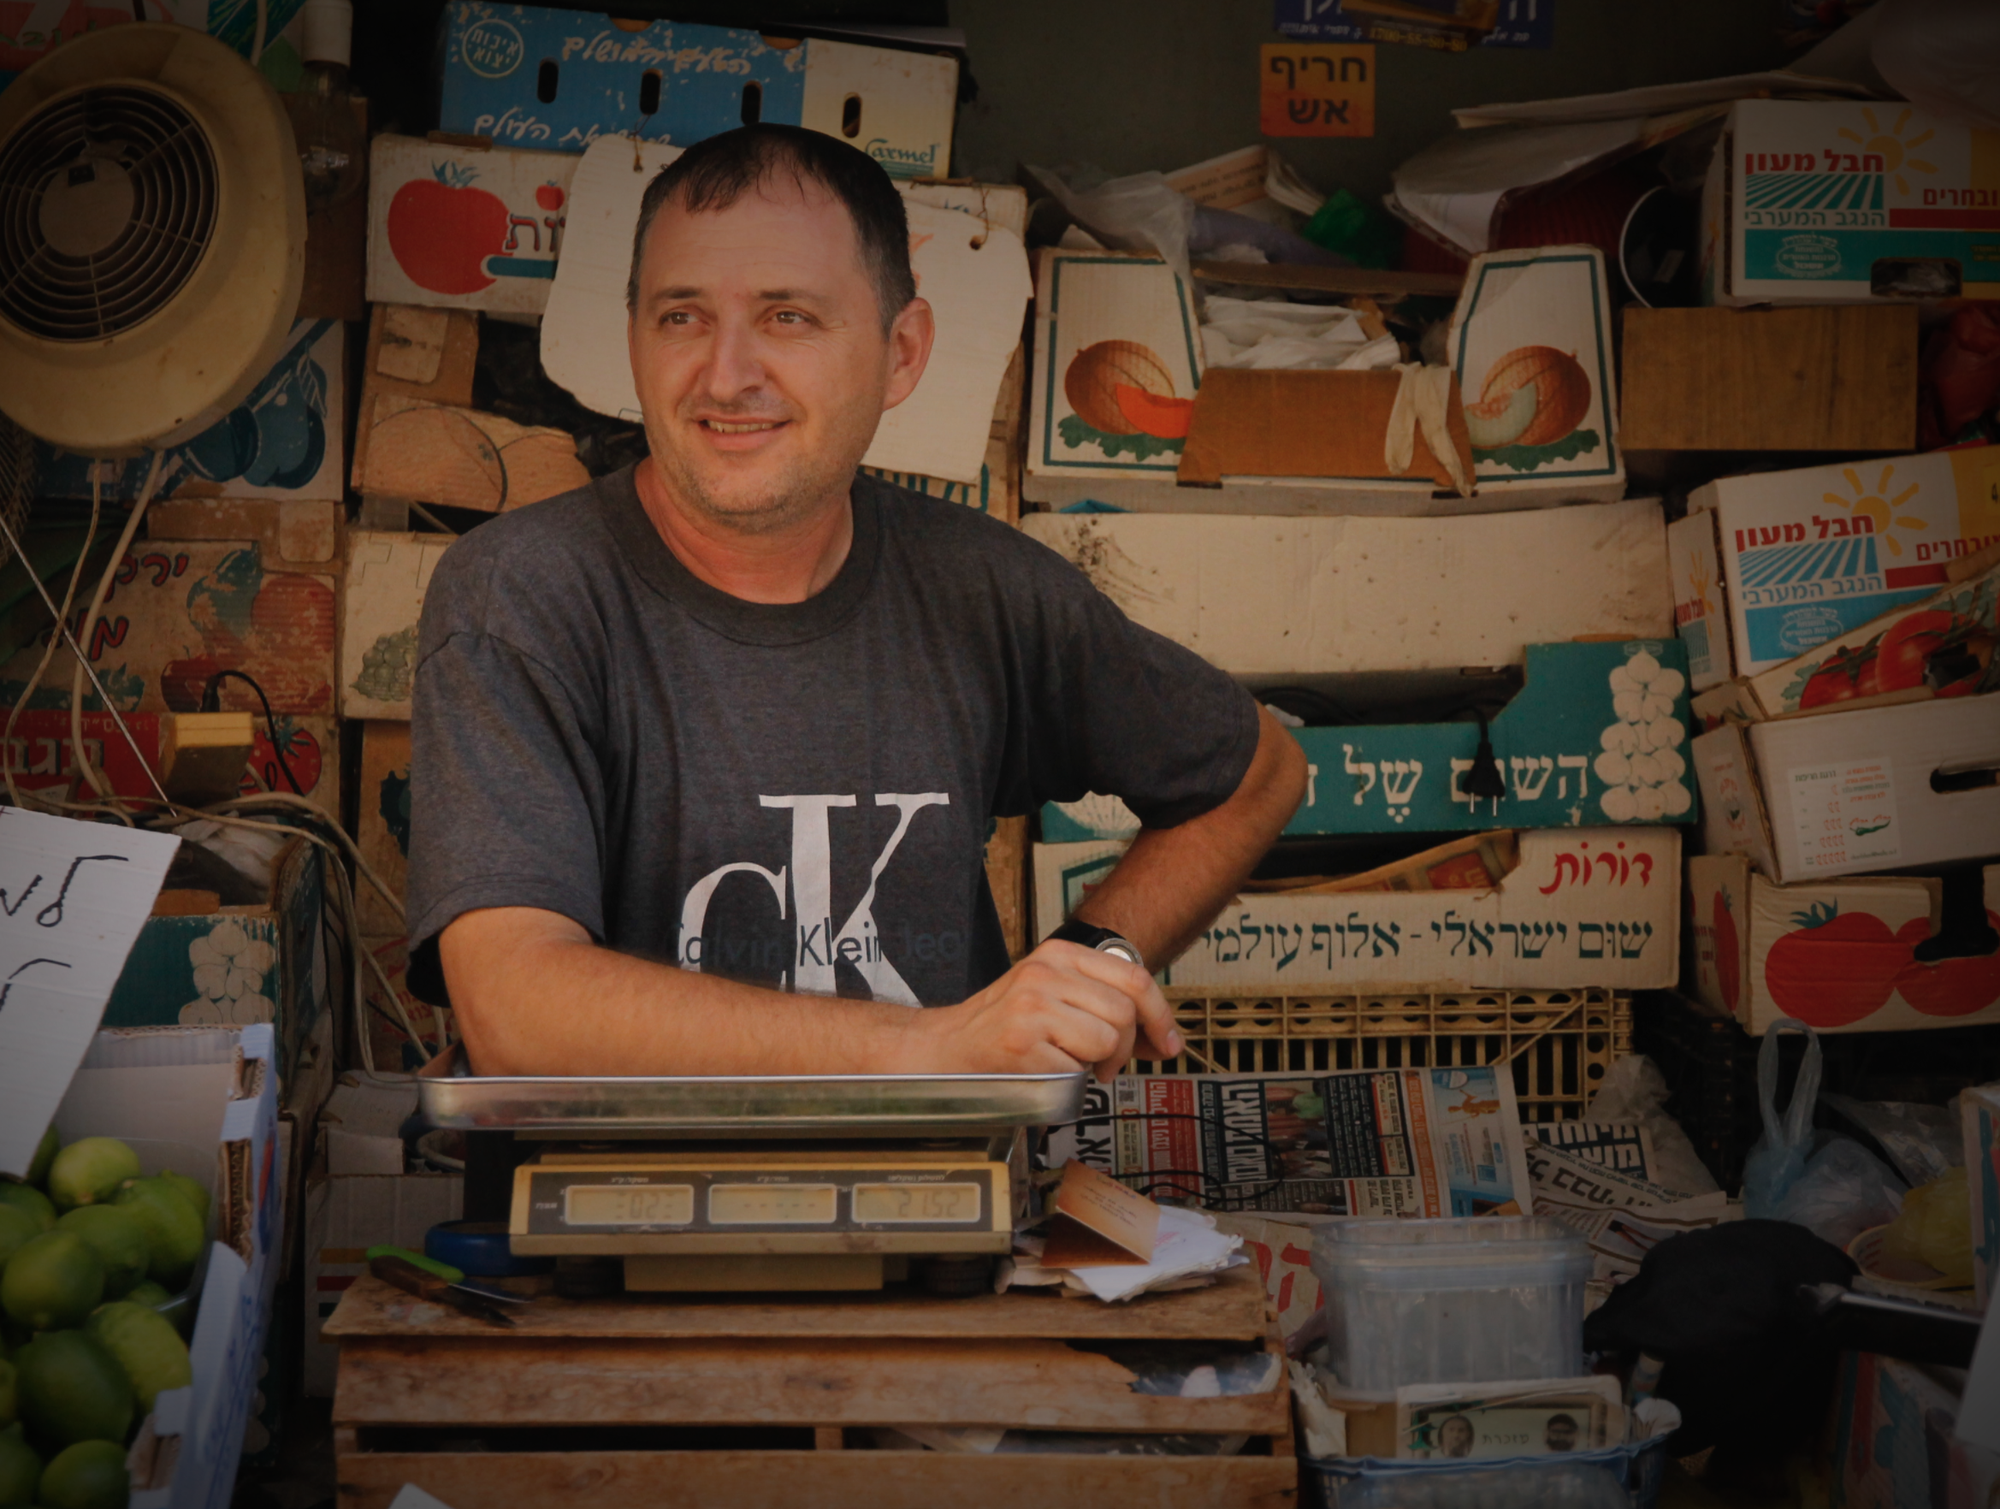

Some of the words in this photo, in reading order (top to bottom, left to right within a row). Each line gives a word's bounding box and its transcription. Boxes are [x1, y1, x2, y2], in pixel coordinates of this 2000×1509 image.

[1270, 56, 1367, 90] חריף
[1288, 98, 1349, 124] אש
[865, 138, 937, 164] Carmel
[1823, 149, 1884, 173] חבל
[1745, 153, 1816, 176] מעון
[1923, 187, 2000, 207] ובחרים
[1745, 211, 1826, 227] המערבי
[1836, 210, 1885, 226] הנגב
[1735, 525, 1807, 553] מעון
[1812, 515, 1875, 540] חבל
[1742, 580, 1825, 606] המערבי
[1834, 575, 1883, 594] הנגב
[800, 917, 883, 968] Klein
[1311, 911, 1401, 971] אלוף
[1431, 910, 1568, 960] ישראלי
